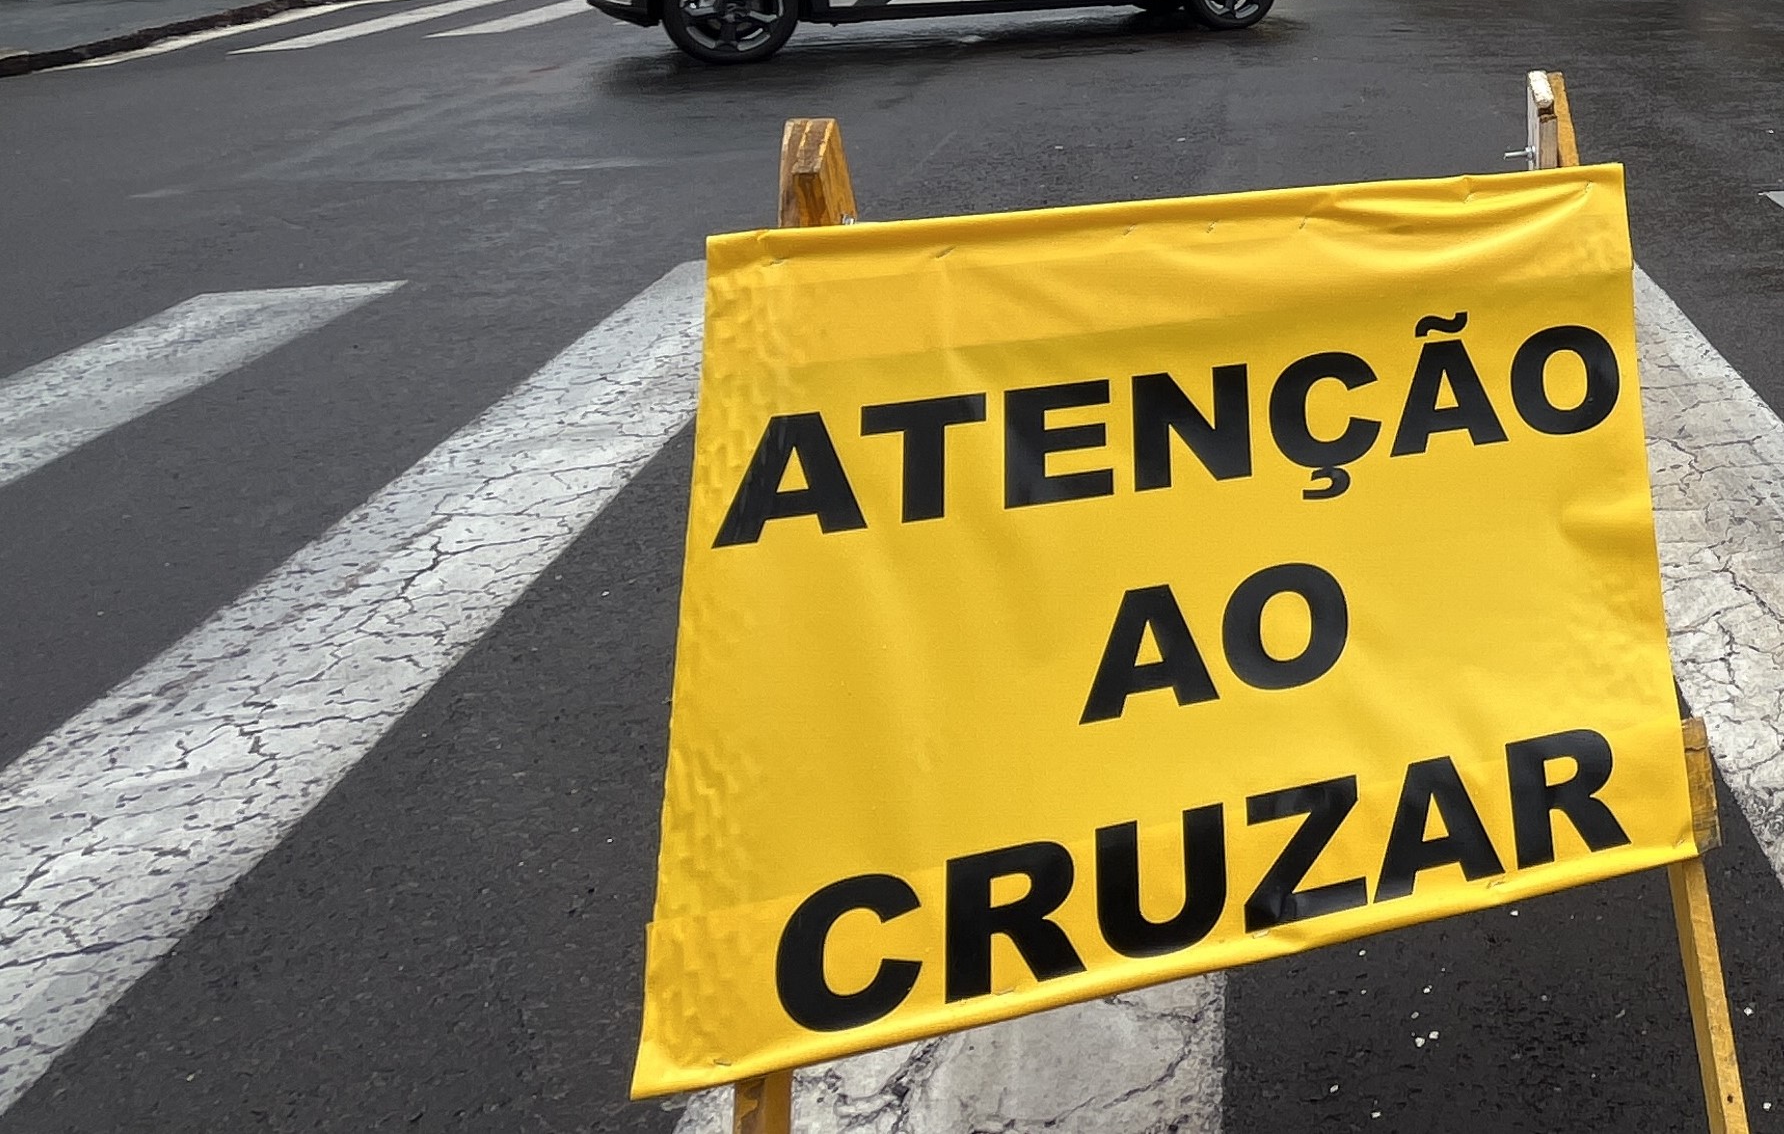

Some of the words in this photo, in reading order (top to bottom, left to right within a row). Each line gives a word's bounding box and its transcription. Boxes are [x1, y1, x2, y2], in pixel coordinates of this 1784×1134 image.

[712, 311, 1621, 549] ATENÇÃO
[1079, 562, 1349, 725] AO
[775, 729, 1631, 1033] CRUZAR
